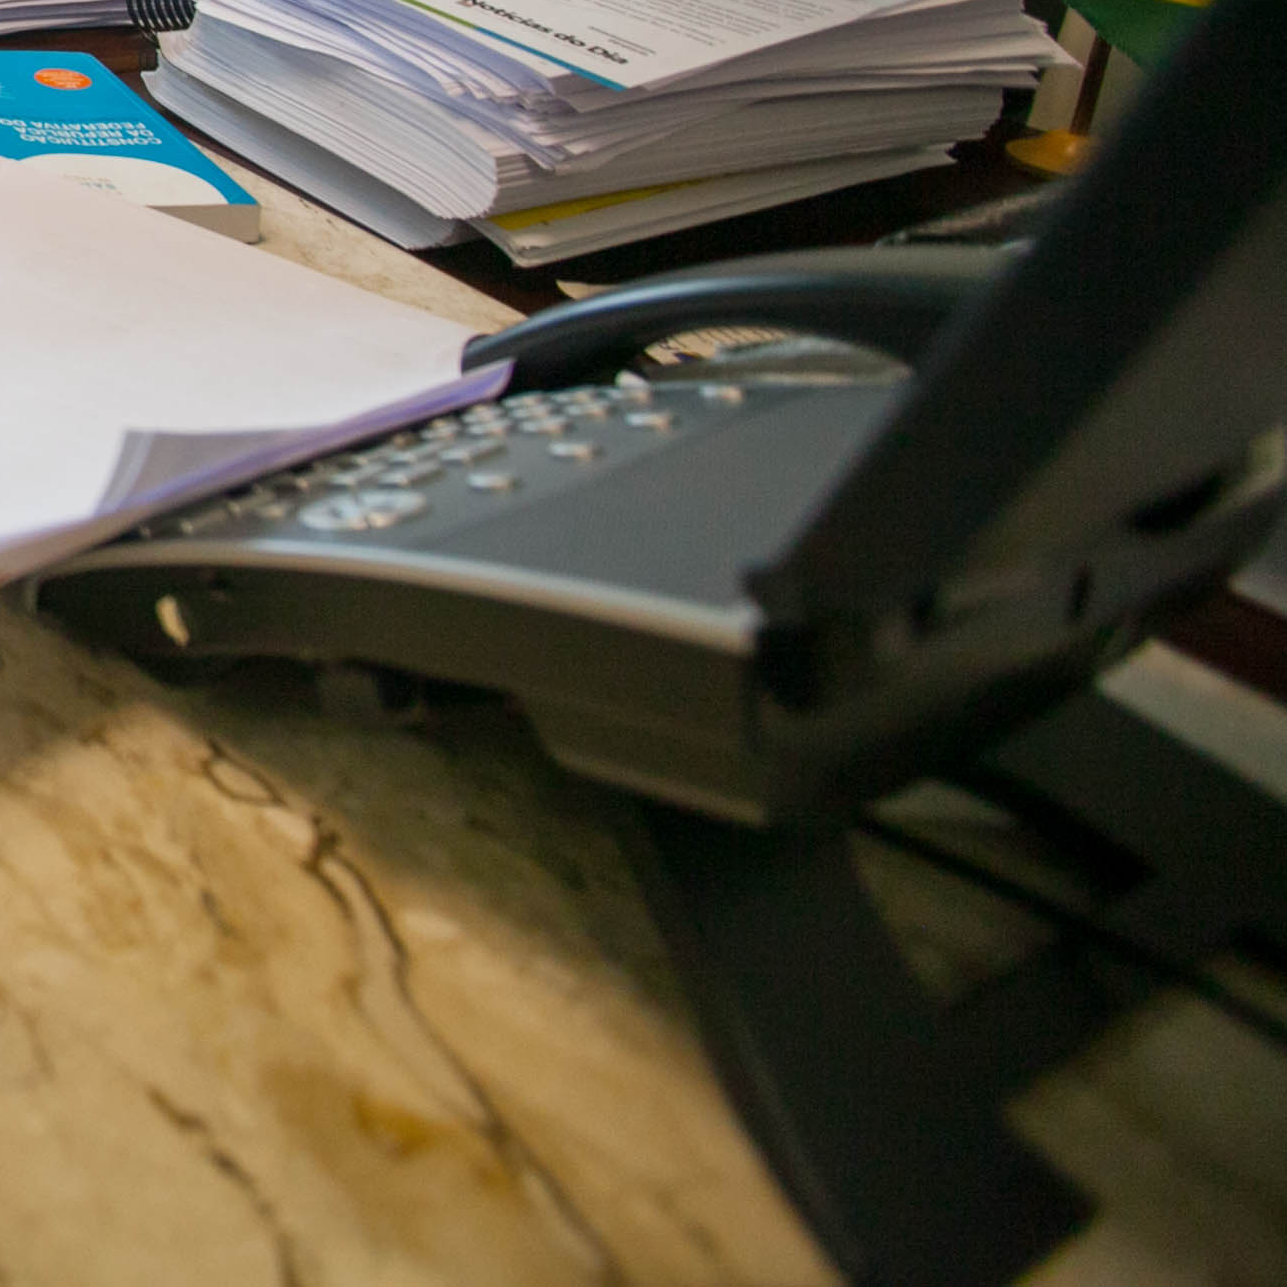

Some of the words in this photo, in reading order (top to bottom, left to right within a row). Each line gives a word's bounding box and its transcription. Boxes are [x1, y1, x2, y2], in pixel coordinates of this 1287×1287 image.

[553, 32, 586, 47] do
[587, 45, 629, 65] Dia
[30, 120, 146, 131] FEDERATIVA
[126, 128, 154, 138] DA
